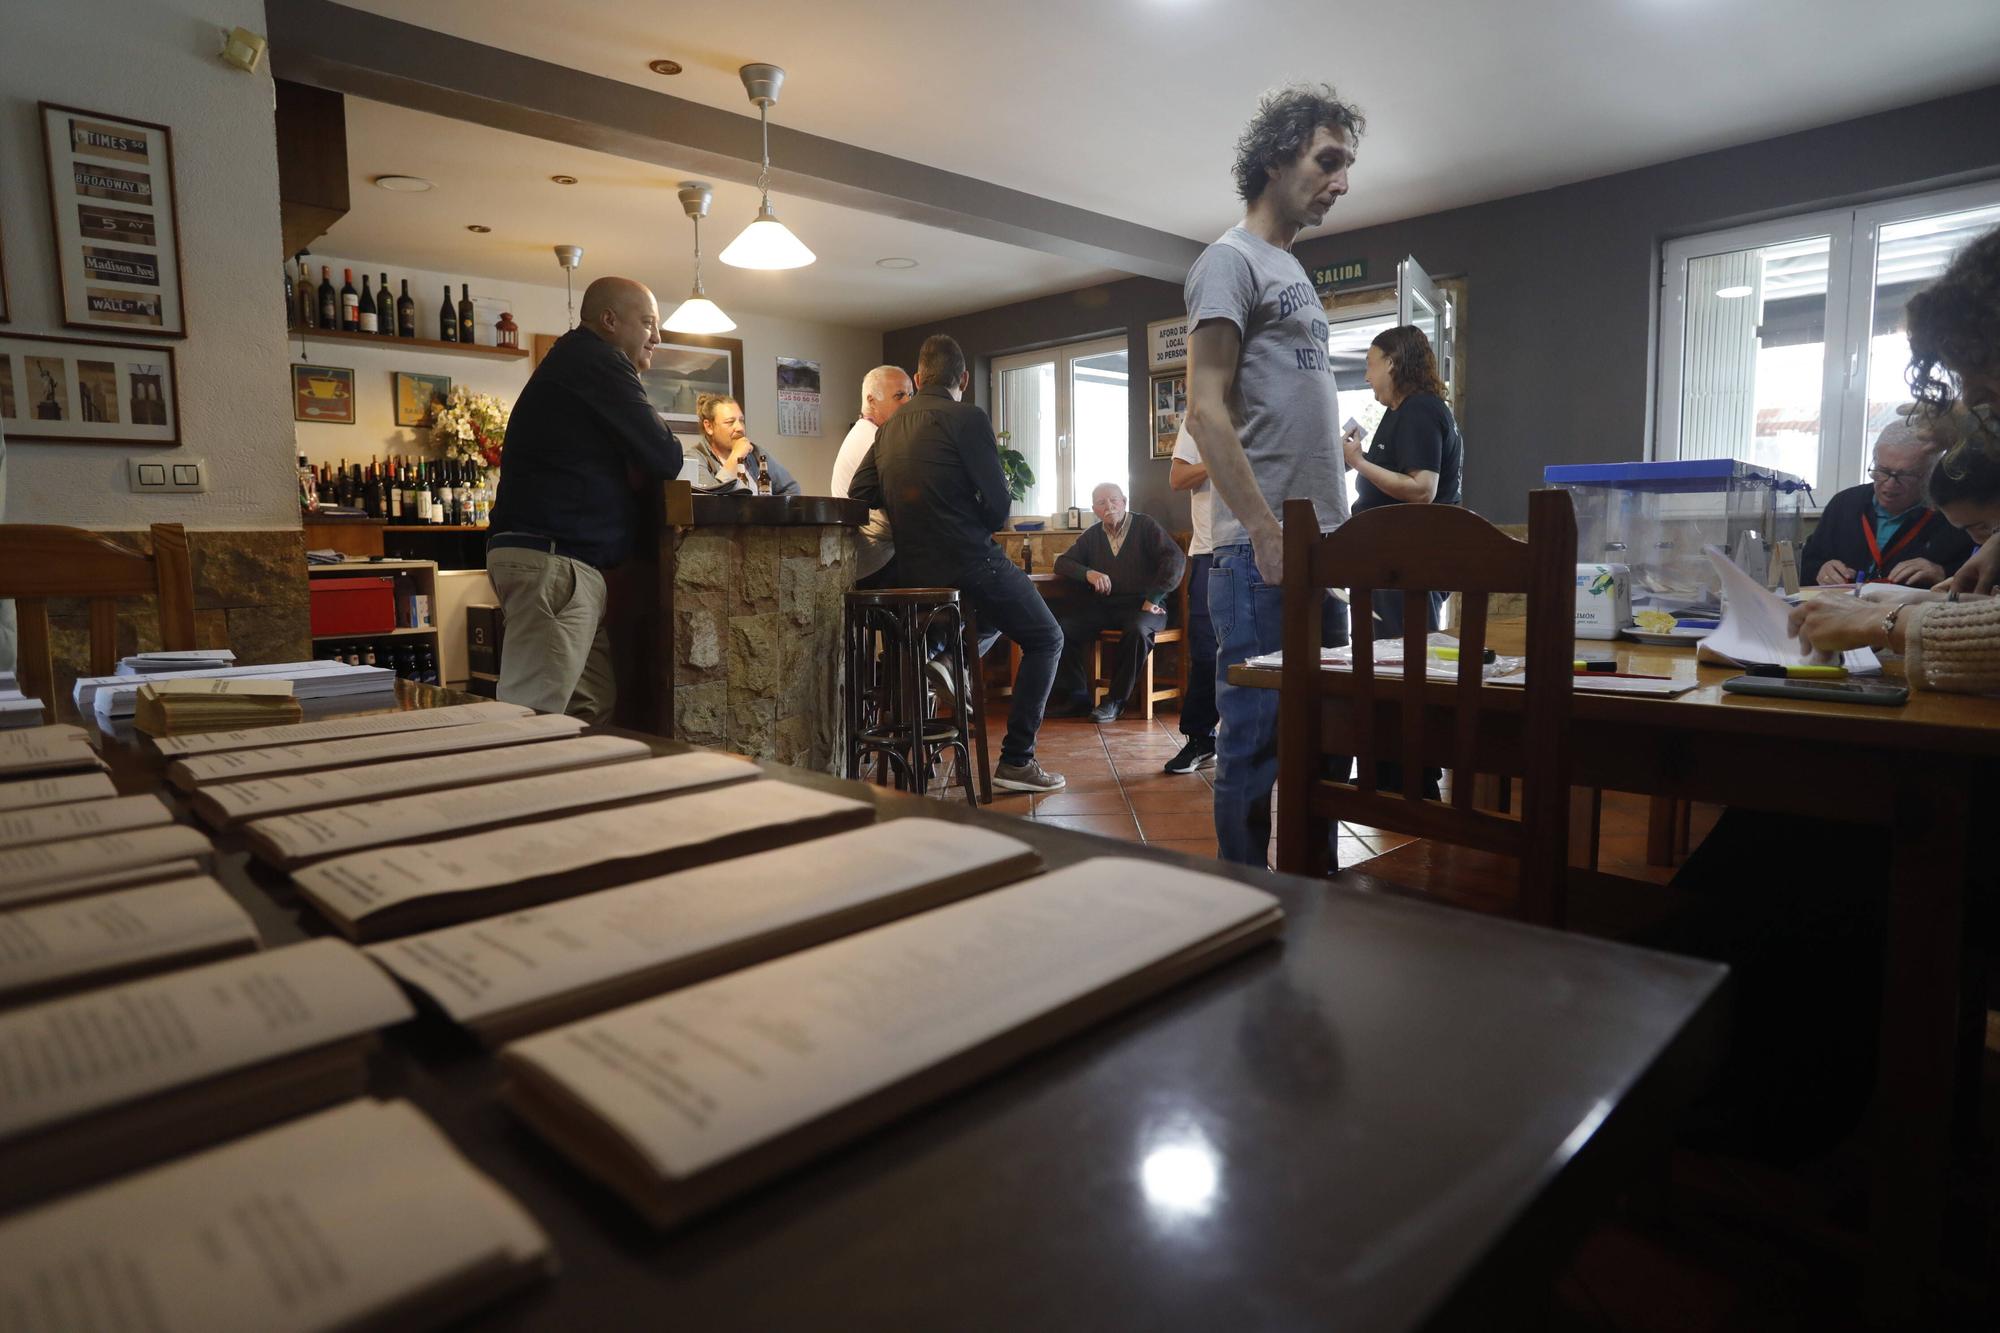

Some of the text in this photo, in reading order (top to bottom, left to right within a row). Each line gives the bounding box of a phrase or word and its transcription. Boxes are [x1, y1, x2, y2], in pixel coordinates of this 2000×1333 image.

[88, 133, 128, 150] TIMES
[75, 174, 135, 192] BROADWAY
[101, 218, 144, 230] 5 AV
[86, 257, 134, 275] Madison
[1316, 263, 1362, 285] SALIDA
[92, 299, 127, 312] WALL
[1159, 327, 1178, 338] AFORO
[1166, 337, 1185, 349] LOCAL
[1296, 348, 1325, 371] NEW
[475, 627, 484, 644] 3
